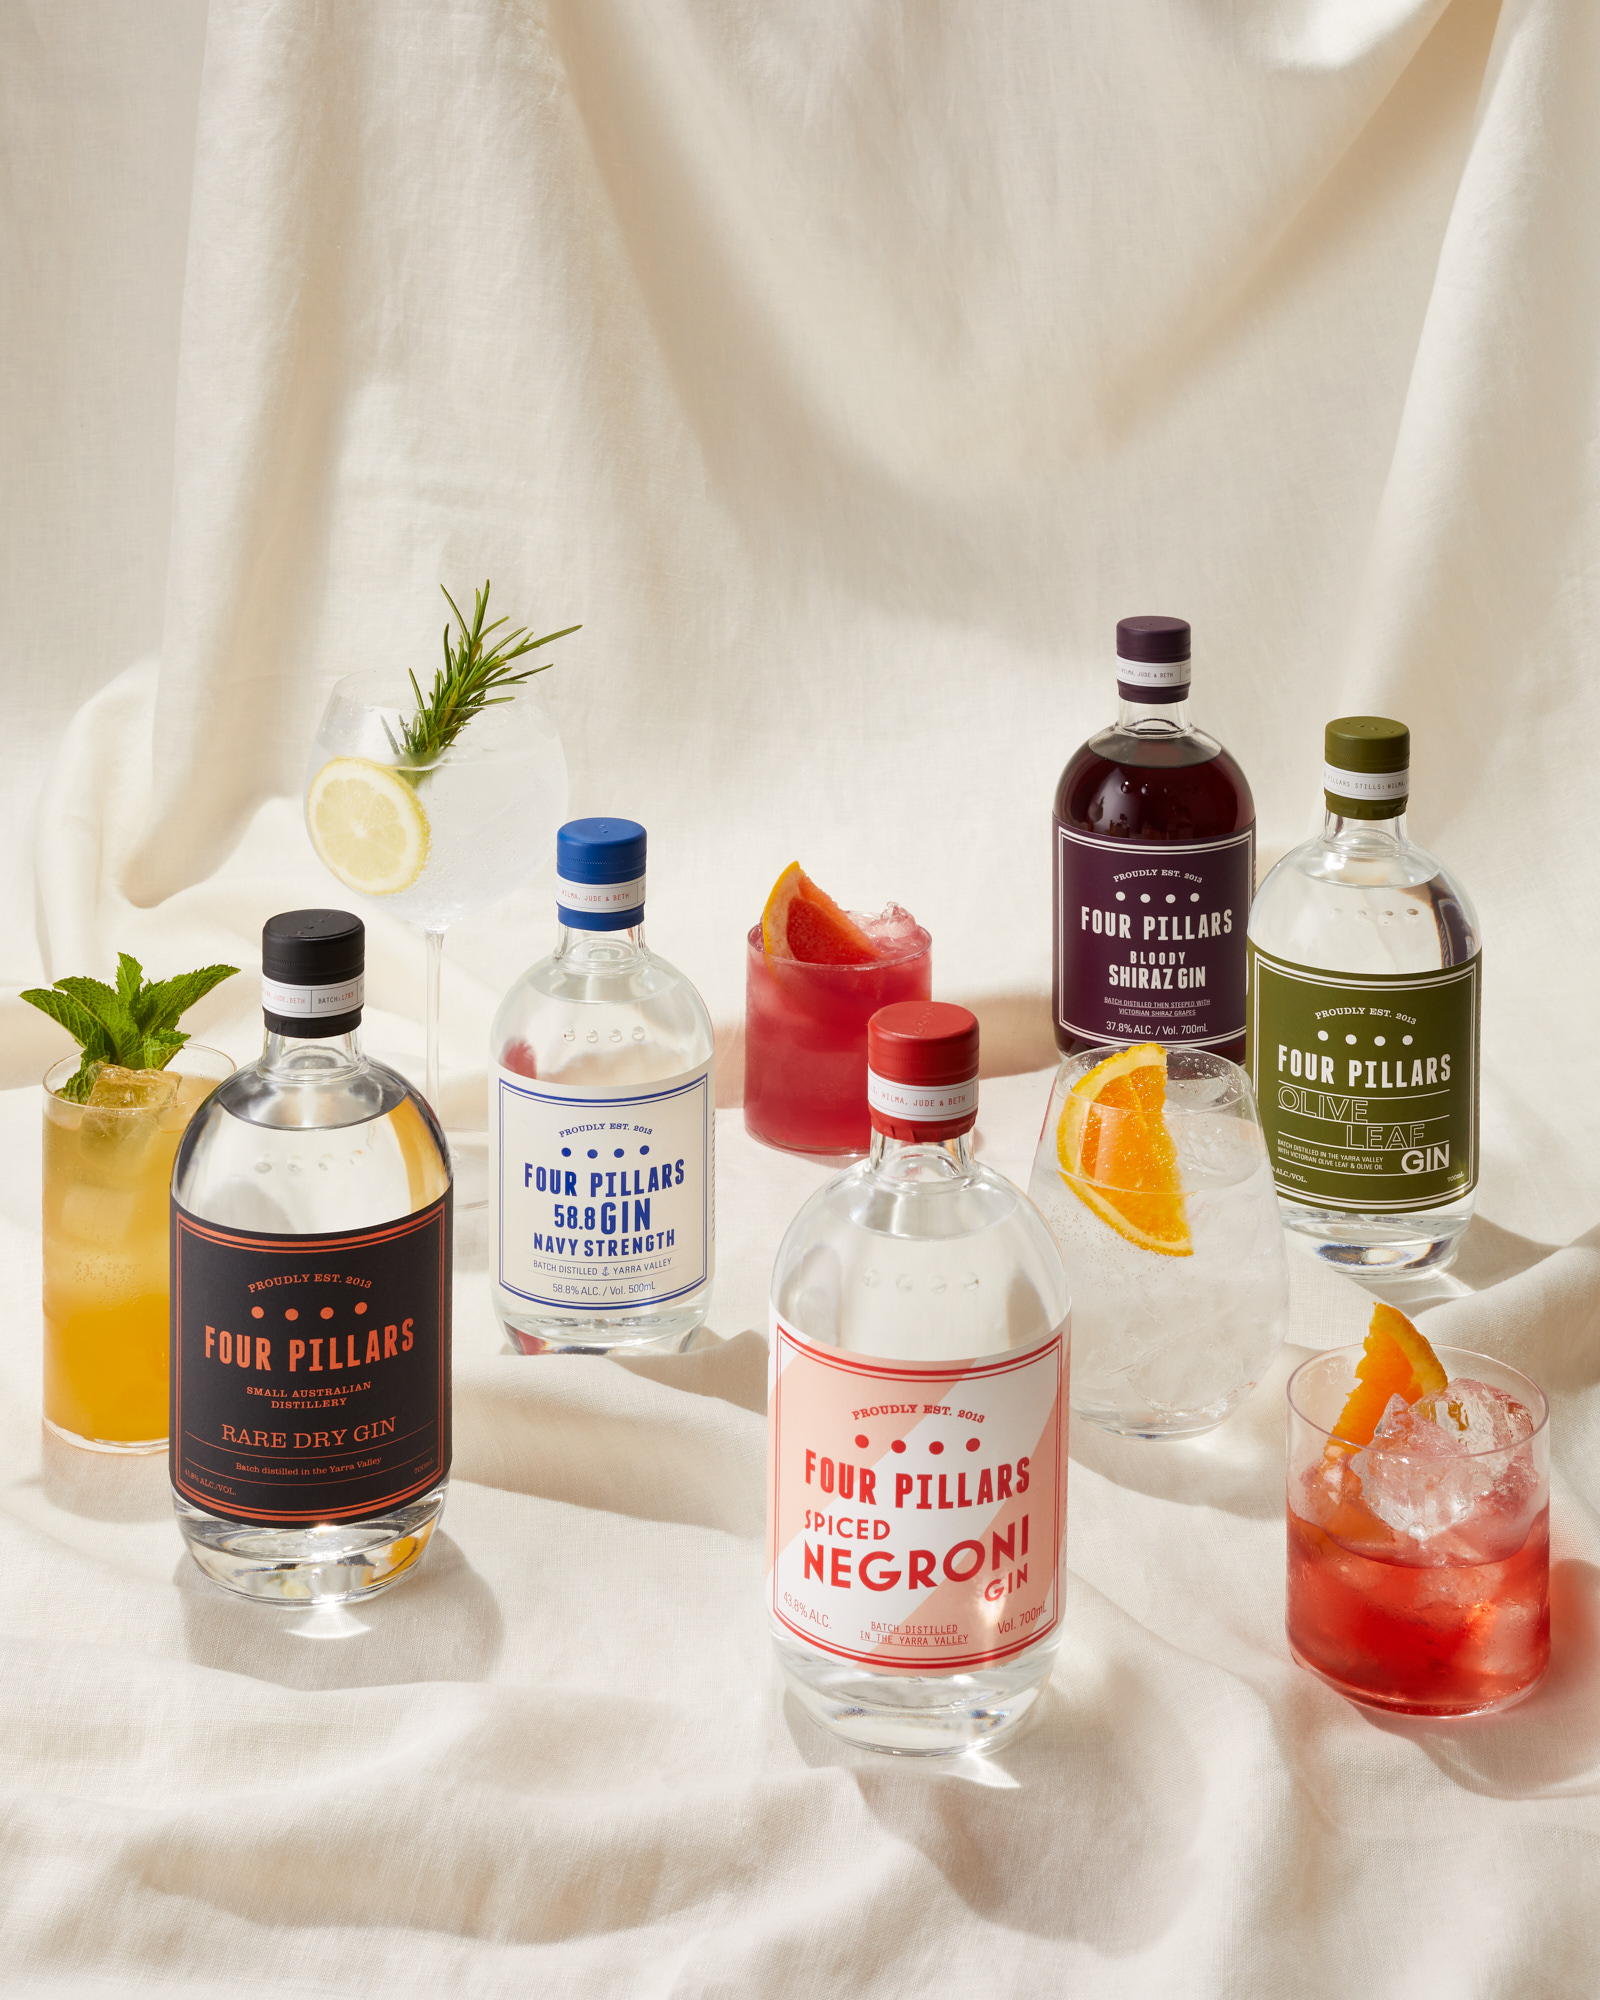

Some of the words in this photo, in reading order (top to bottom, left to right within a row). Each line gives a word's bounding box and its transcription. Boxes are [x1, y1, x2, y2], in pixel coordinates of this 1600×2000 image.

[1328, 776, 1350, 787] PILLARS
[1113, 869, 1158, 882] PROUDLY
[1184, 873, 1202, 883] 2013
[1082, 906, 1131, 939] FOUR
[1144, 909, 1232, 940] PILLARS
[1130, 951, 1186, 965] BLOODY
[1109, 964, 1173, 989] SHIRAZ
[1178, 966, 1206, 989] GIN
[1104, 997, 1122, 1005] BATCH
[1171, 1000, 1195, 1008] STEEPED
[1119, 1008, 1149, 1016] VICTORIAN
[1315, 1007, 1365, 1019] PROUDLY
[1370, 1008, 1392, 1018] EST.
[1396, 1013, 1416, 1024] 2013
[1106, 1021, 1132, 1033] 37.8%
[1134, 1025, 1153, 1034] ALC.
[1155, 1025, 1160, 1036] /
[1162, 1026, 1178, 1035] Vol.
[1181, 1023, 1208, 1034] 700mL
[1278, 1044, 1334, 1084] FOUR
[1349, 1054, 1450, 1088] PILLARS
[882, 1092, 908, 1106] WILMA,
[948, 1095, 965, 1105] BETH
[1278, 1086, 1368, 1123] OLIVE
[559, 1123, 605, 1138] PROUDLY
[610, 1123, 629, 1131] EST.
[634, 1125, 653, 1135] 2013
[1346, 1124, 1425, 1150] LEAF
[1278, 1139, 1292, 1149] BATCH
[1294, 1143, 1318, 1156] DISTILLED
[1278, 1147, 1290, 1155] WITH
[1291, 1150, 1316, 1164] VICTORIAN
[1318, 1158, 1333, 1166] OLIVE
[1402, 1144, 1449, 1174] GIN
[525, 1162, 577, 1196] FOUR
[590, 1159, 684, 1197] PILLARS
[554, 1204, 595, 1230] 58.8
[601, 1198, 650, 1235] GIN
[534, 1232, 578, 1256] NAVY
[584, 1229, 675, 1257] STRENGTH
[534, 1260, 556, 1272] BATCH
[559, 1265, 598, 1275] DISTILLED
[613, 1264, 641, 1274] YARRA
[644, 1257, 672, 1271] VALLEY
[248, 1274, 310, 1293] PROUDLY
[314, 1274, 342, 1283] EST.
[346, 1275, 372, 1289] 2013
[553, 1283, 579, 1295] 58.8%
[581, 1286, 601, 1296] ALC.
[602, 1286, 608, 1297] /
[610, 1286, 626, 1296] Vol.
[629, 1282, 656, 1294] 500mL
[205, 1325, 272, 1371] FOUR
[289, 1318, 414, 1372] PILLARS
[247, 1387, 287, 1398] SMALL
[292, 1381, 371, 1398] AUSTRALIAN
[271, 1398, 347, 1409] DISTILLERY
[852, 1405, 918, 1420] PROUDLY
[923, 1405, 952, 1416] EST.
[958, 1409, 985, 1423] 2013
[222, 1424, 287, 1448] RARE
[293, 1430, 348, 1448] DRY
[354, 1416, 396, 1442] GIN
[236, 1462, 260, 1473] Batch
[262, 1465, 298, 1475] distilled
[301, 1467, 310, 1475] in
[312, 1465, 327, 1474] the
[329, 1464, 355, 1473] Yarra
[357, 1457, 381, 1471] Valley
[200, 1478, 236, 1495] ALC./VOL.
[805, 1448, 876, 1505] FOUR
[895, 1456, 1030, 1510] PILLARS
[805, 1510, 890, 1540] SPICED
[804, 1514, 1028, 1592] NEGRONI
[985, 1562, 1028, 1602] GIN
[784, 1591, 808, 1618] 43.8%
[809, 1609, 832, 1629] ALC.
[997, 1619, 1017, 1634] Vol.
[1019, 1601, 1047, 1626] 700mL
[871, 1621, 899, 1632] BATCH
[906, 1624, 958, 1634] DISTILLED
[860, 1631, 870, 1639] IN
[877, 1634, 893, 1643] THE
[899, 1636, 928, 1646] YARRA
[934, 1634, 968, 1644] VALLEY
